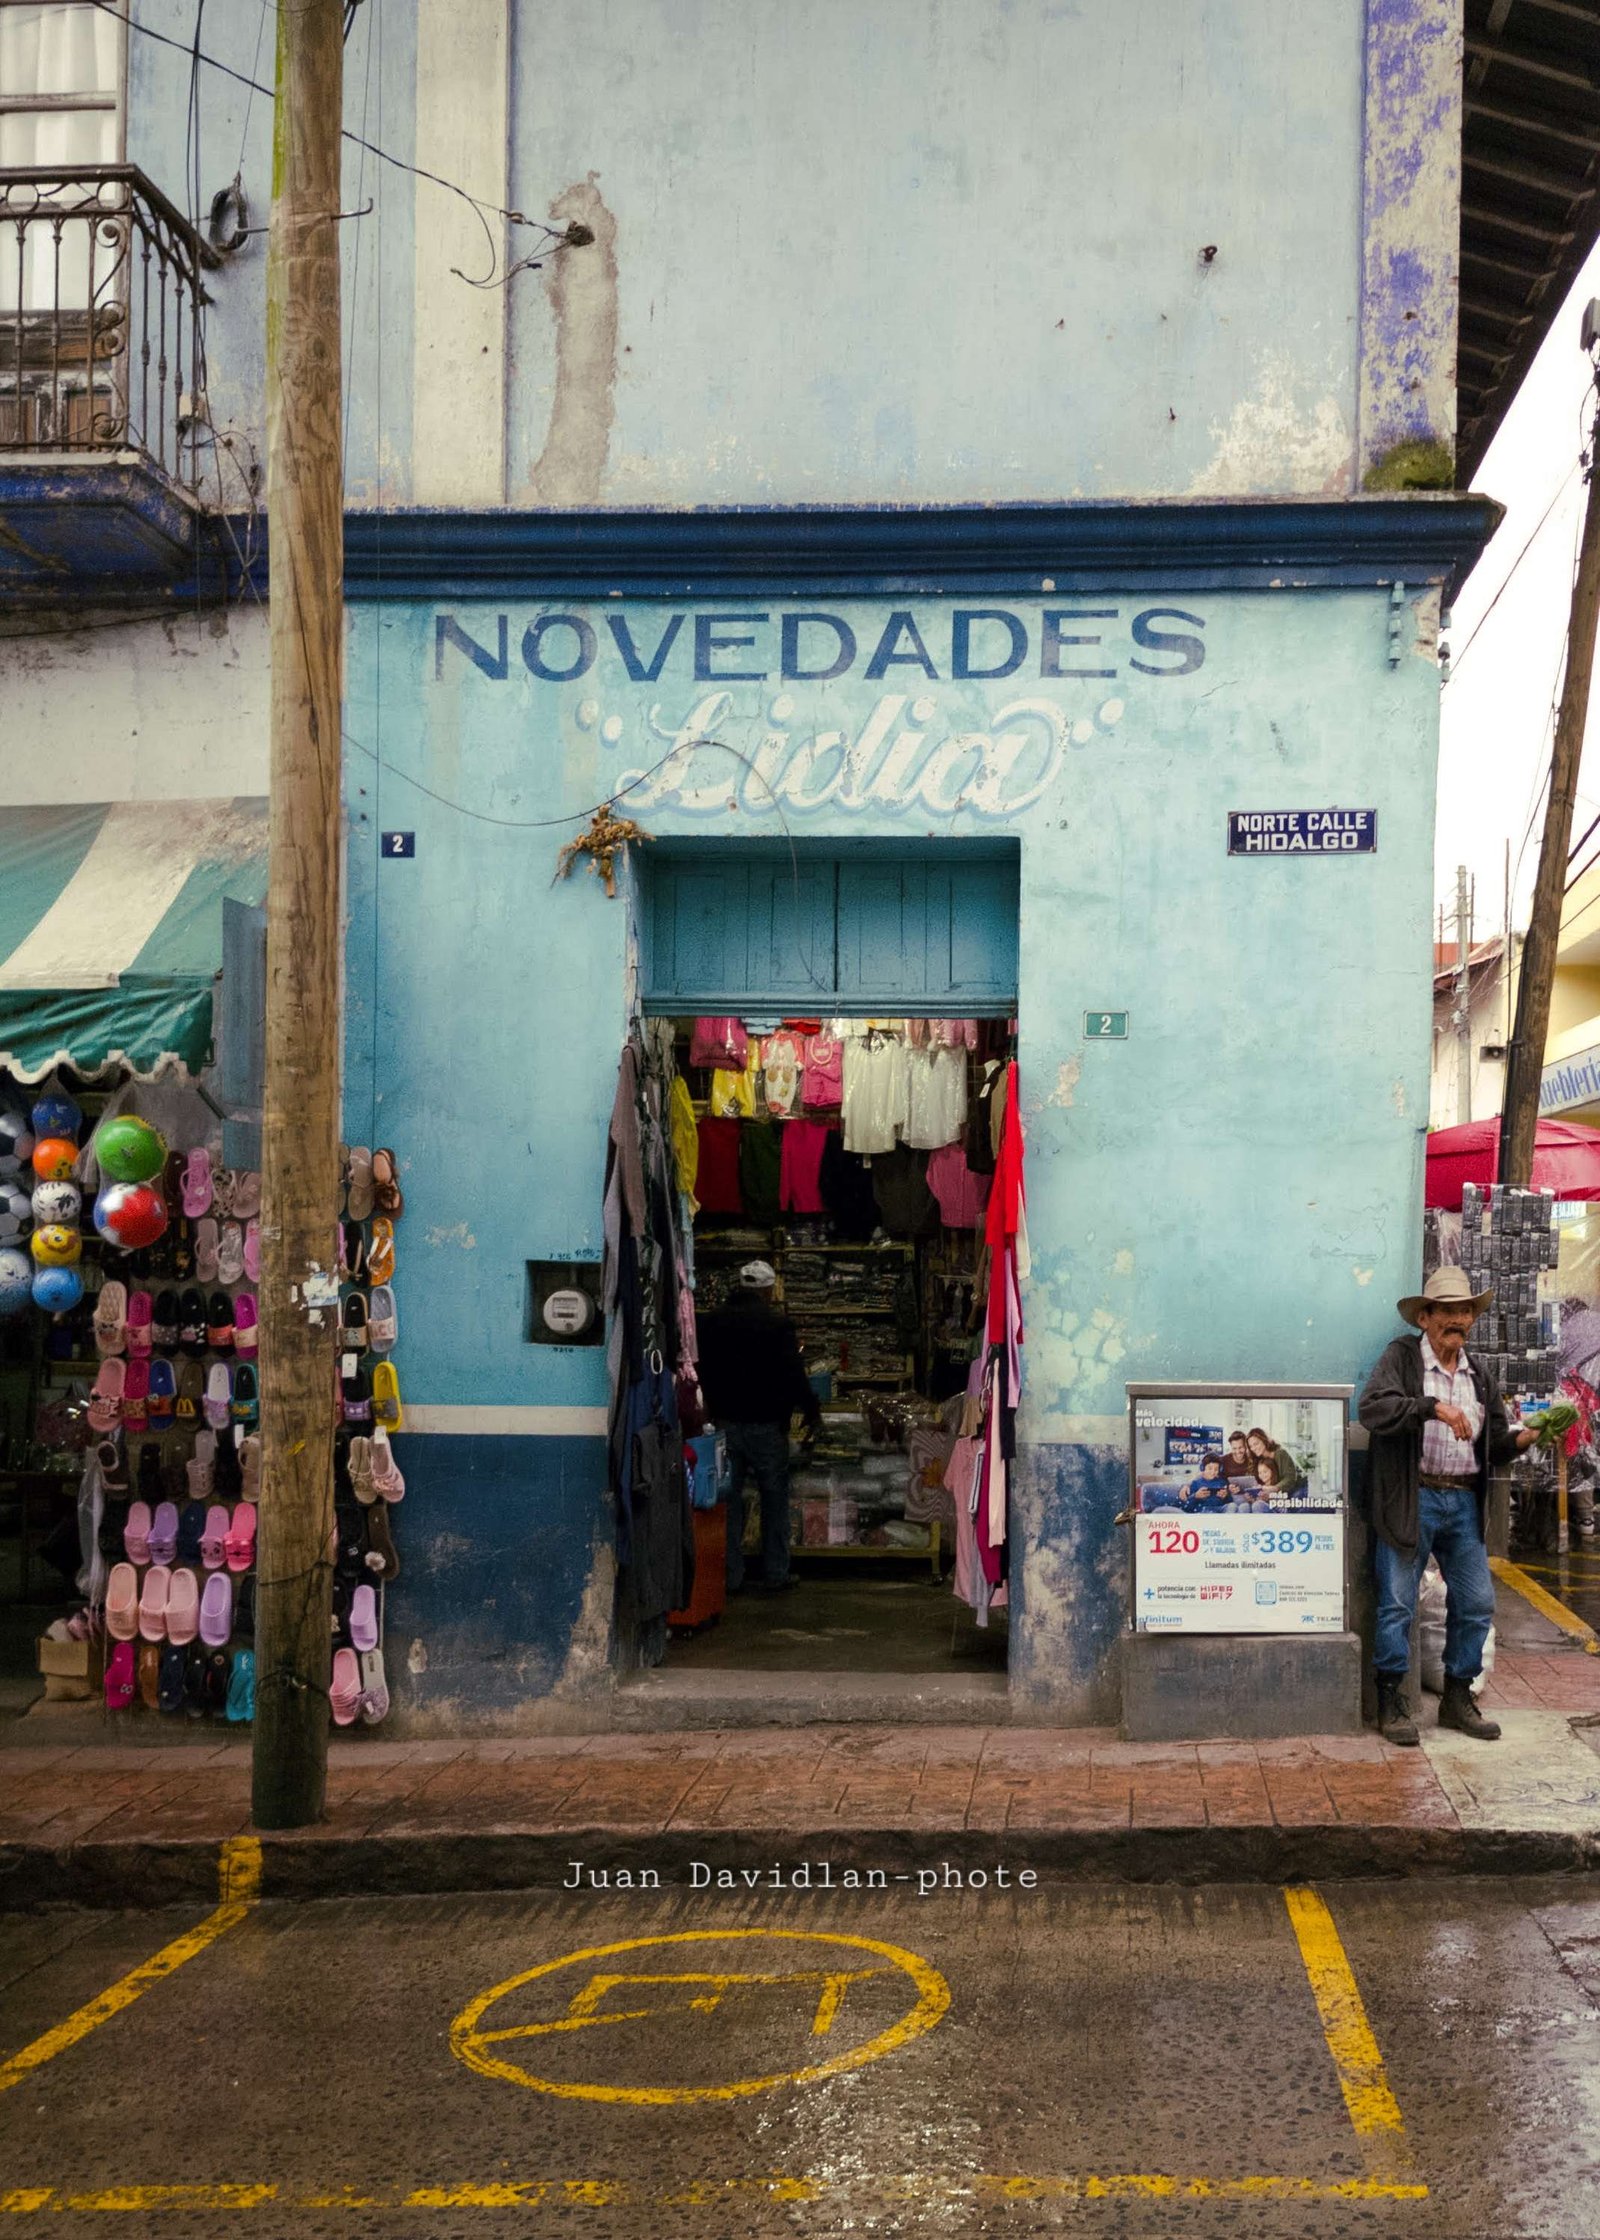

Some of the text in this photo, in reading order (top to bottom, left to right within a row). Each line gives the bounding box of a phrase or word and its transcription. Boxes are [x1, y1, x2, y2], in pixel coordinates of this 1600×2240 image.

[433, 606, 1207, 684] NOVEDADES
[614, 689, 1068, 820] Lidia
[1237, 811, 1368, 832] NORTE CALLE
[392, 834, 404, 853] 2
[1245, 831, 1359, 852] HIDALGO
[1099, 1014, 1112, 1034] 2
[1135, 1416, 1203, 1429] velocidad,
[1269, 1490, 1288, 1499] más
[1148, 1521, 1181, 1530] AHORA
[1148, 1530, 1200, 1554] 120
[1251, 1530, 1313, 1554] $389
[1204, 1561, 1277, 1569] Llamadas ilimitadas
[1200, 1585, 1233, 1593] HIPER
[1137, 1615, 1183, 1625] nfinitum
